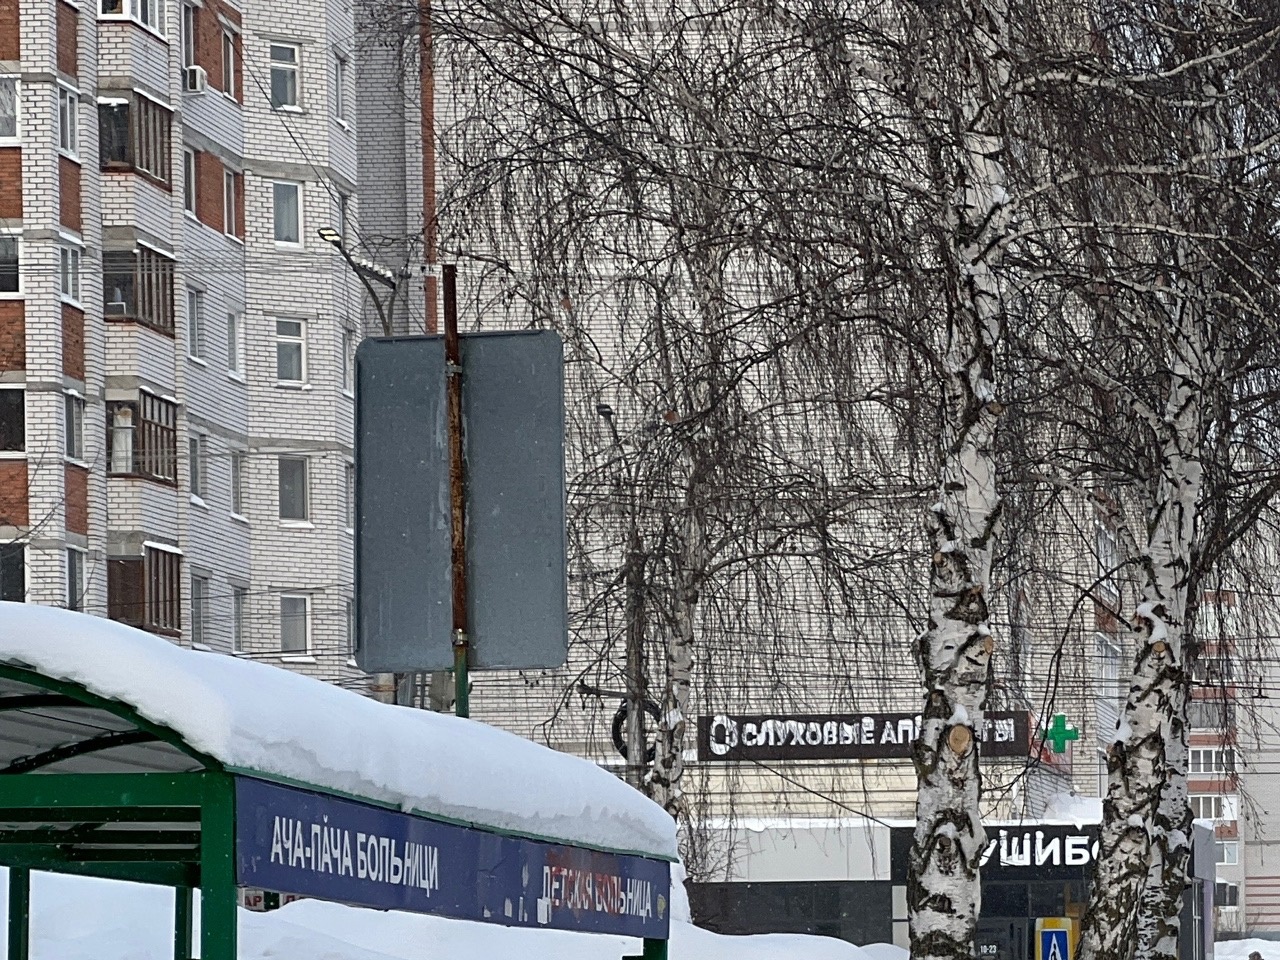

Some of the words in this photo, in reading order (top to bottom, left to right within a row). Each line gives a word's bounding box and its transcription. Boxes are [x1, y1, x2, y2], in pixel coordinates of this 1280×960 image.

[741, 717, 875, 746] СЛУХОВЫЕ
[357, 832, 438, 897] БОЛЬНИЦИ
[595, 873, 652, 924] БОЛЬНИЦА
